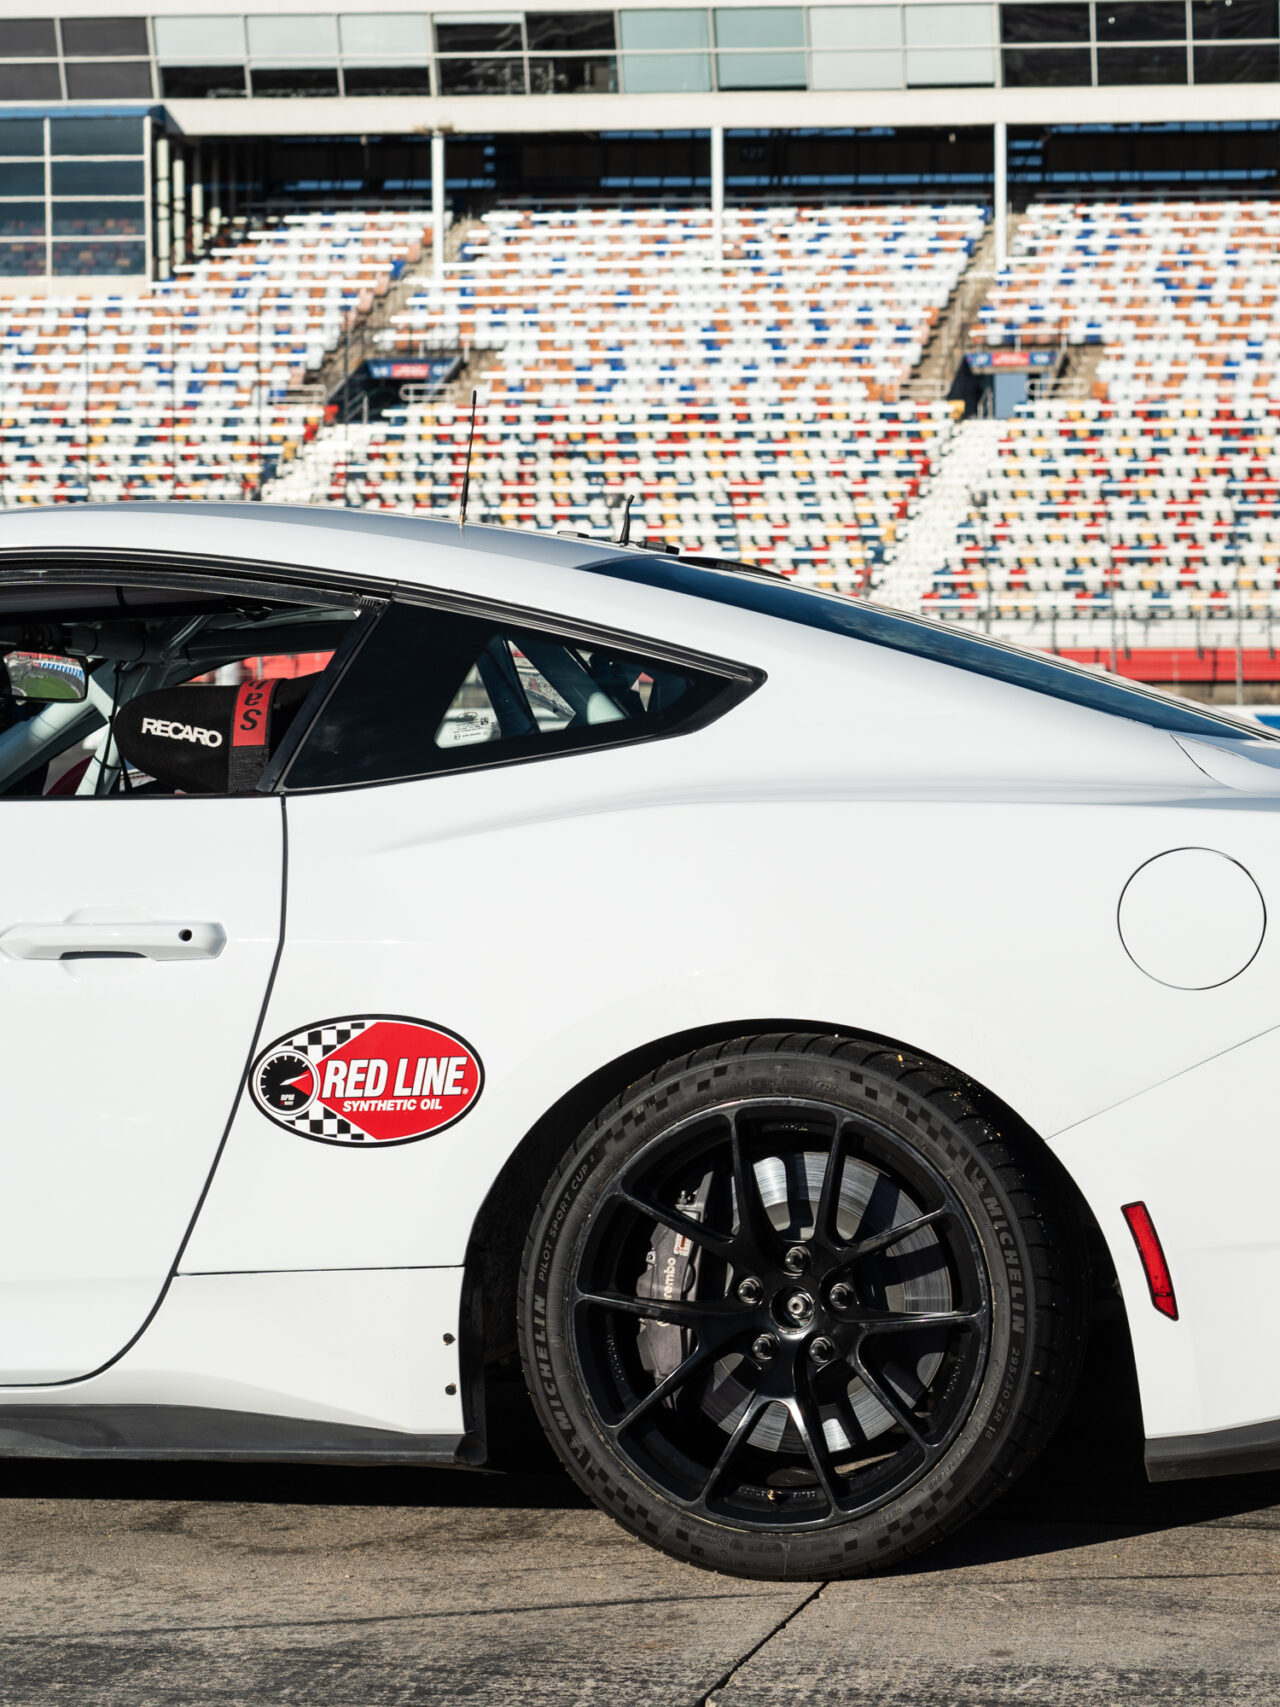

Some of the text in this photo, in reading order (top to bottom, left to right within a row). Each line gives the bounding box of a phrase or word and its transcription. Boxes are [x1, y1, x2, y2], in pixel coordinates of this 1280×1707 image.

[142, 718, 222, 747] RECARO
[322, 1056, 467, 1098] RED LINE
[342, 1099, 442, 1112] SYNTHETIC OIL
[570, 1164, 589, 1190] CUP
[548, 1192, 573, 1239] SPORT
[538, 1241, 553, 1282] PILOT
[984, 1195, 1024, 1334] MICHELIN
[534, 1294, 572, 1432] MICHELIN
